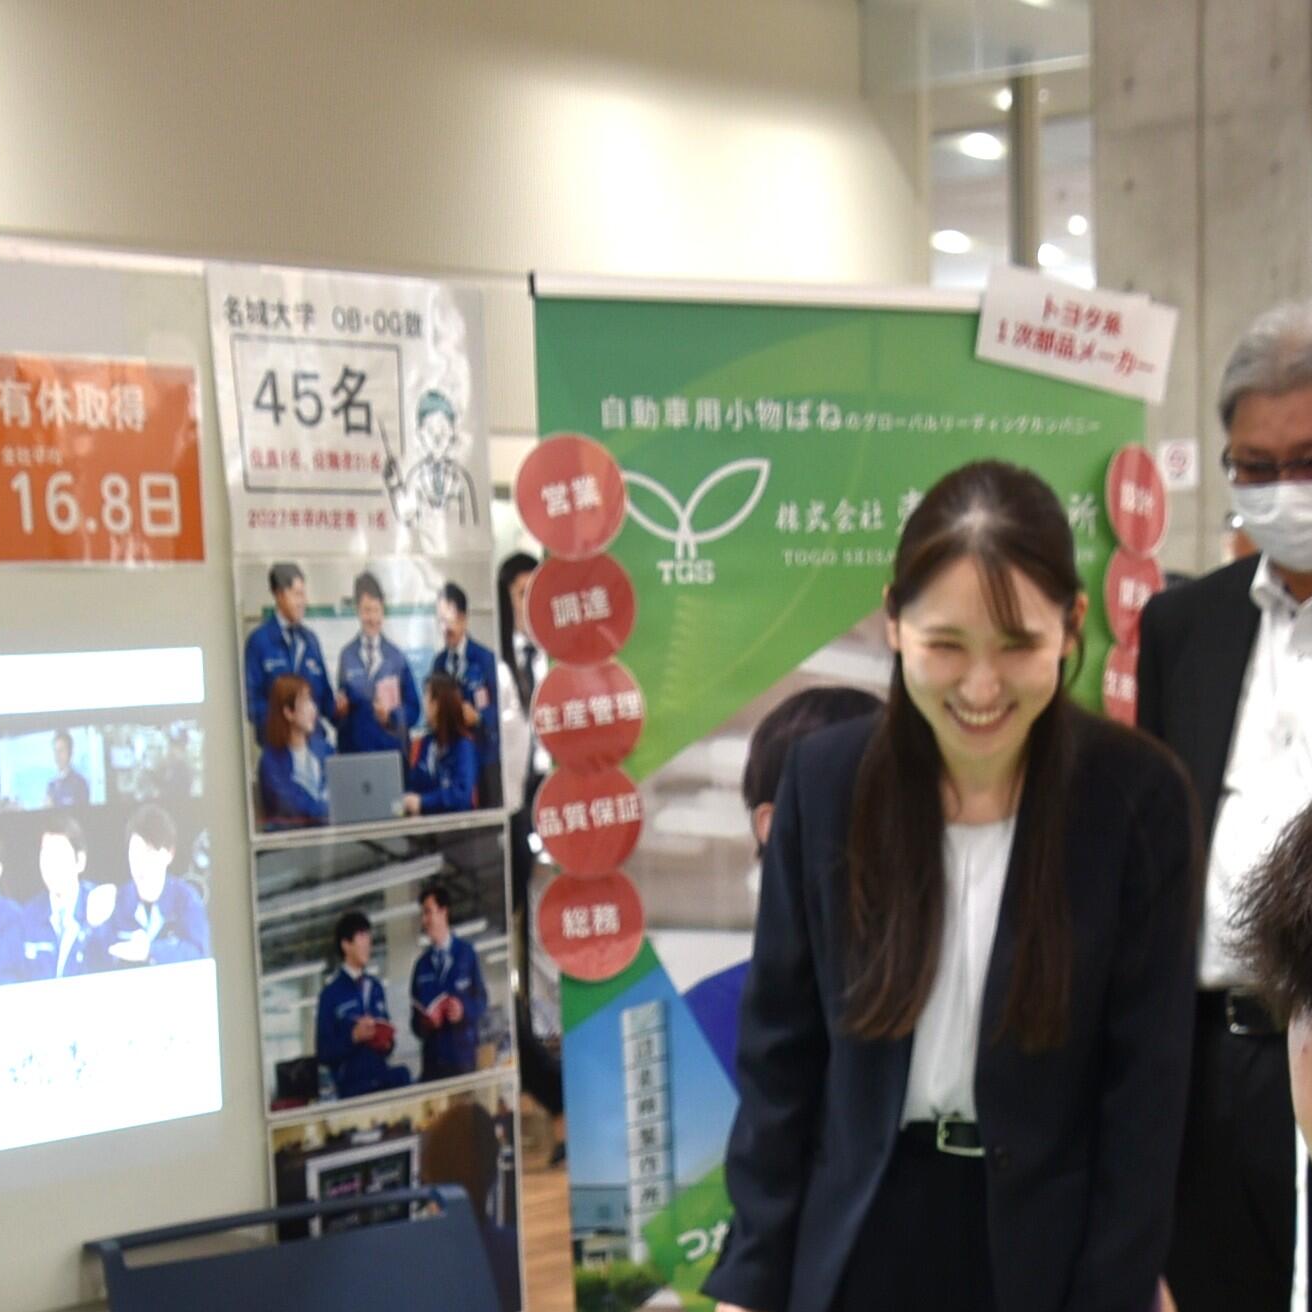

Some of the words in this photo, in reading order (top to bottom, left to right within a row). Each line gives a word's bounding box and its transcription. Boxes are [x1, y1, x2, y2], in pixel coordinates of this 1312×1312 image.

[253, 366, 373, 436] 45名
[10, 470, 182, 537] 16.8日
[540, 475, 602, 519] 営業
[657, 559, 716, 586] TGS
[550, 586, 610, 630] 調達
[534, 689, 644, 735] 生産管理
[536, 792, 643, 838] 品質保証
[561, 903, 621, 939] 総務
